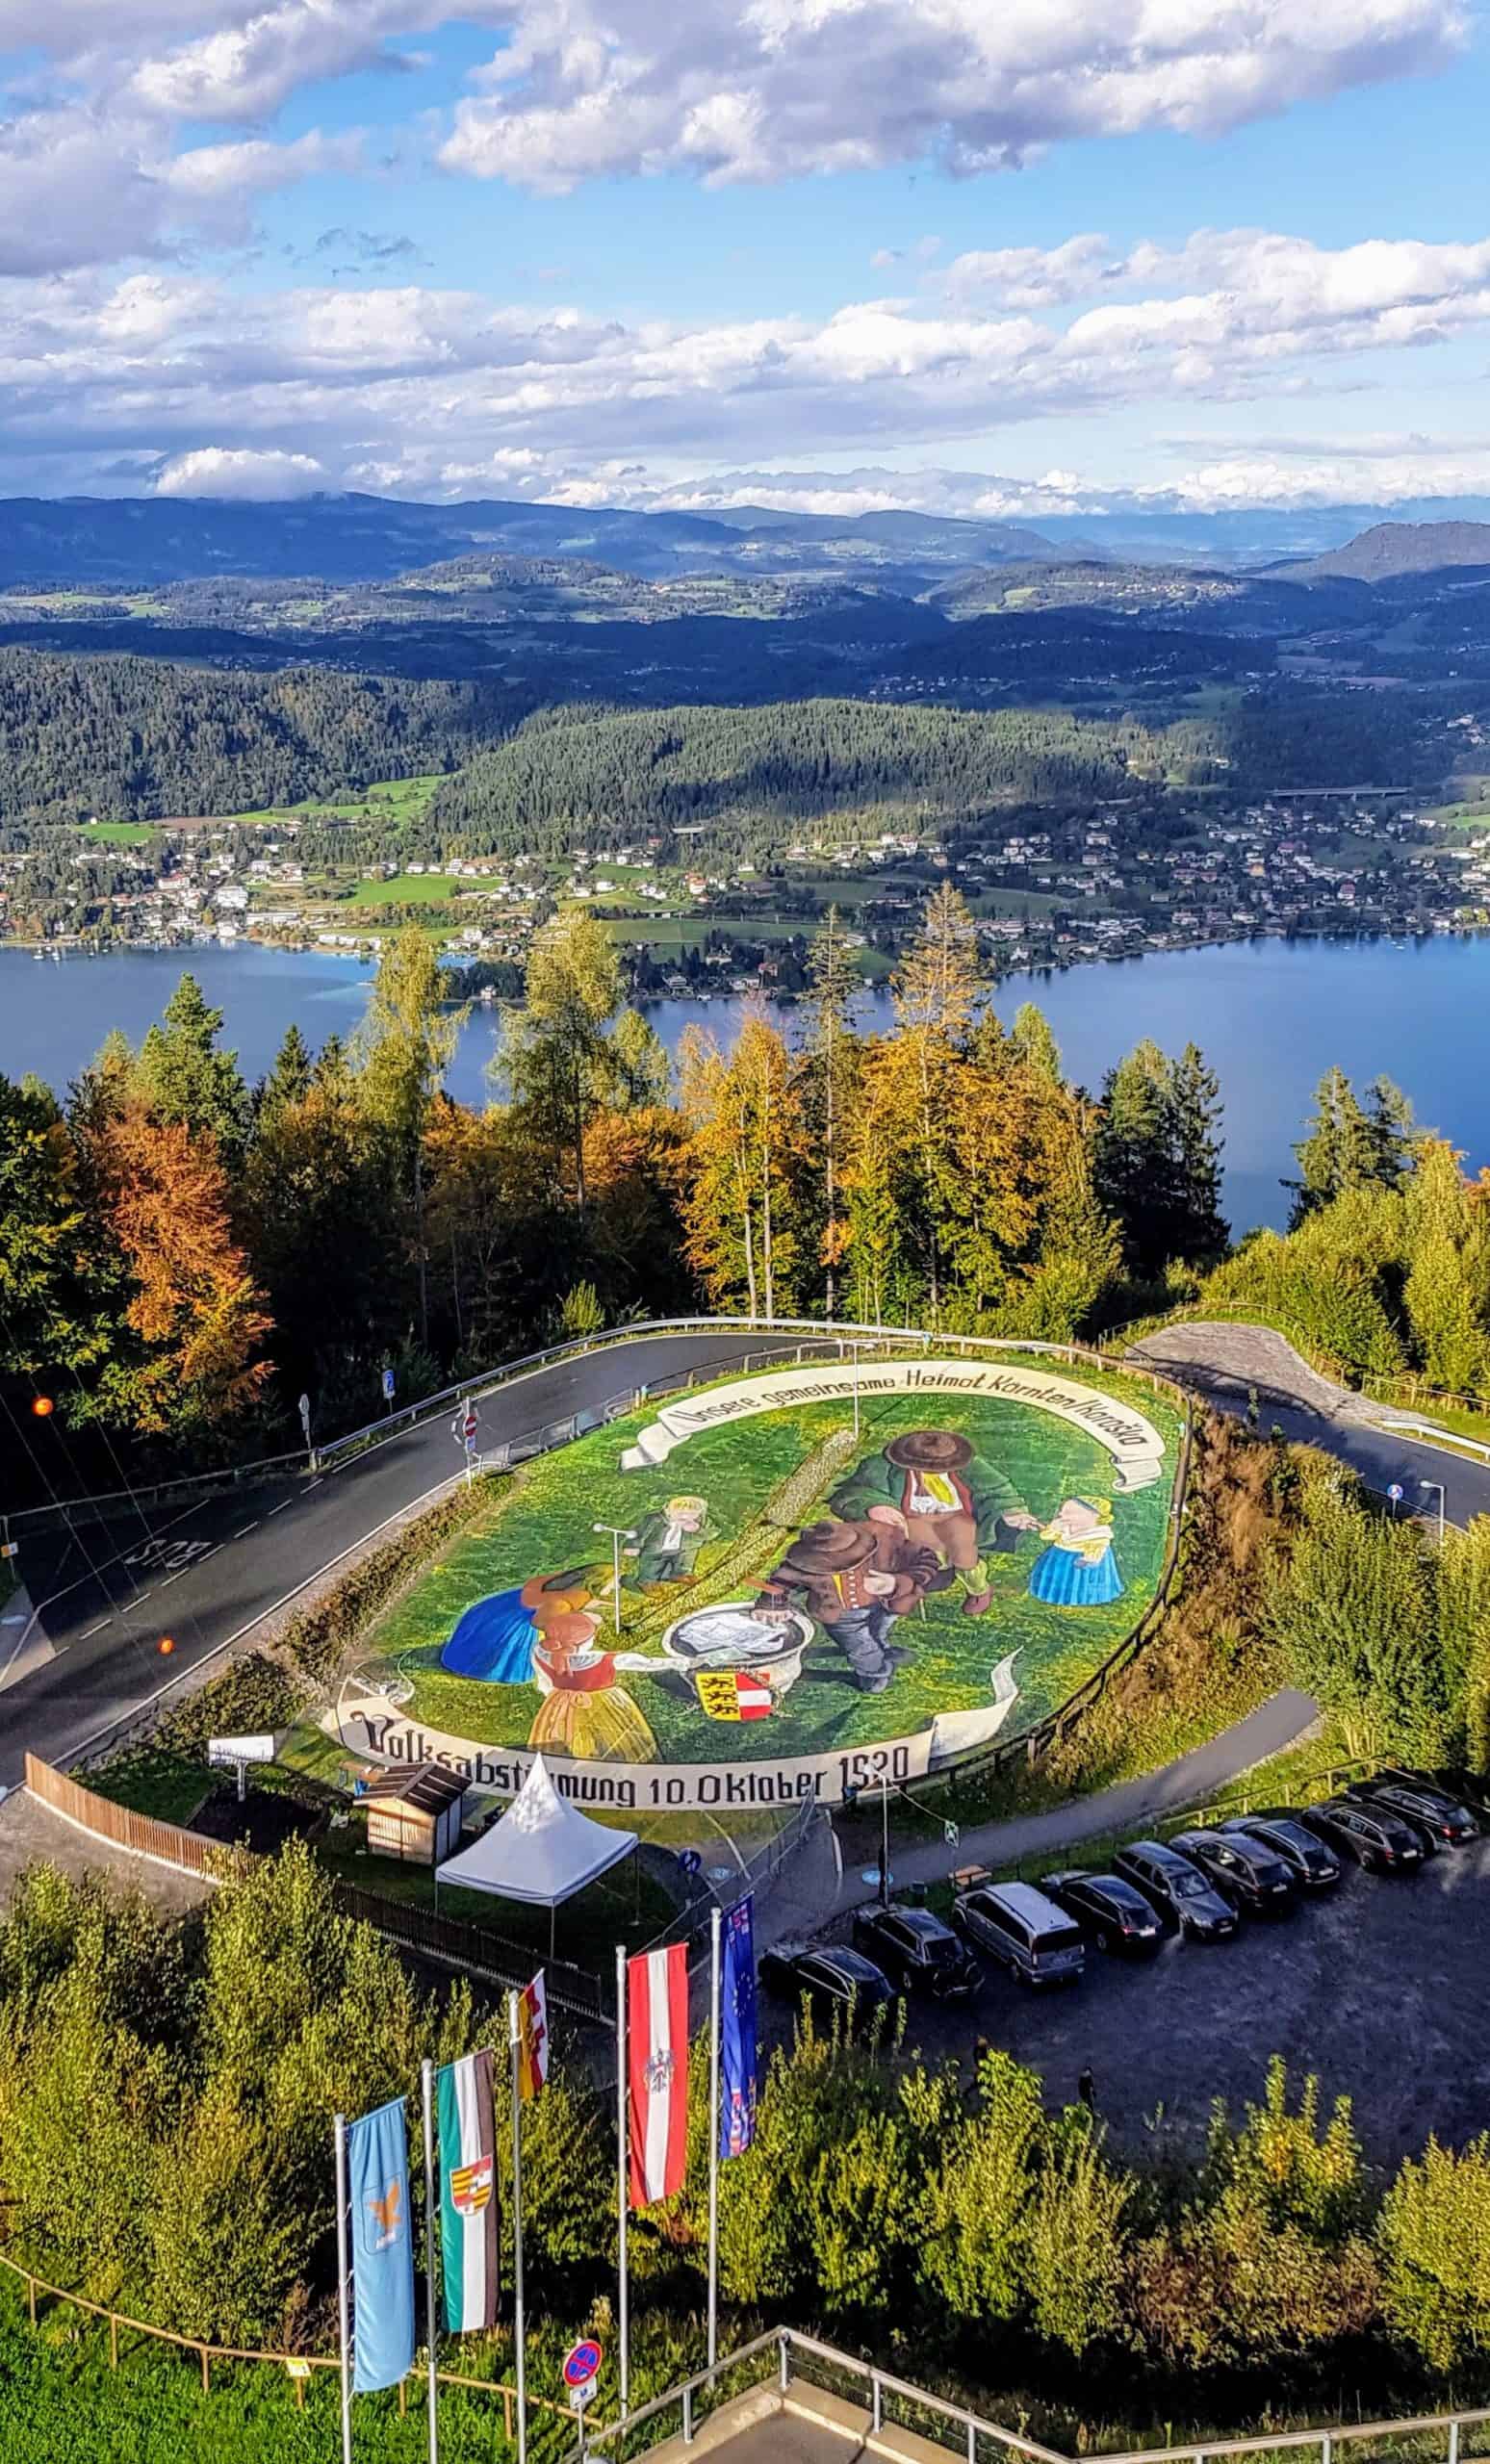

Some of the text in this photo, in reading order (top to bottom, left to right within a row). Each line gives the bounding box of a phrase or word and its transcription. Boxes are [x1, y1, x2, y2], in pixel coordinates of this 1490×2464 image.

[667, 1397, 761, 1424] Unsere
[761, 1377, 896, 1407] gemeinsame
[906, 1369, 987, 1388] Heimat
[123, 1539, 213, 1569] BUS
[838, 1746, 910, 1791] 1920
